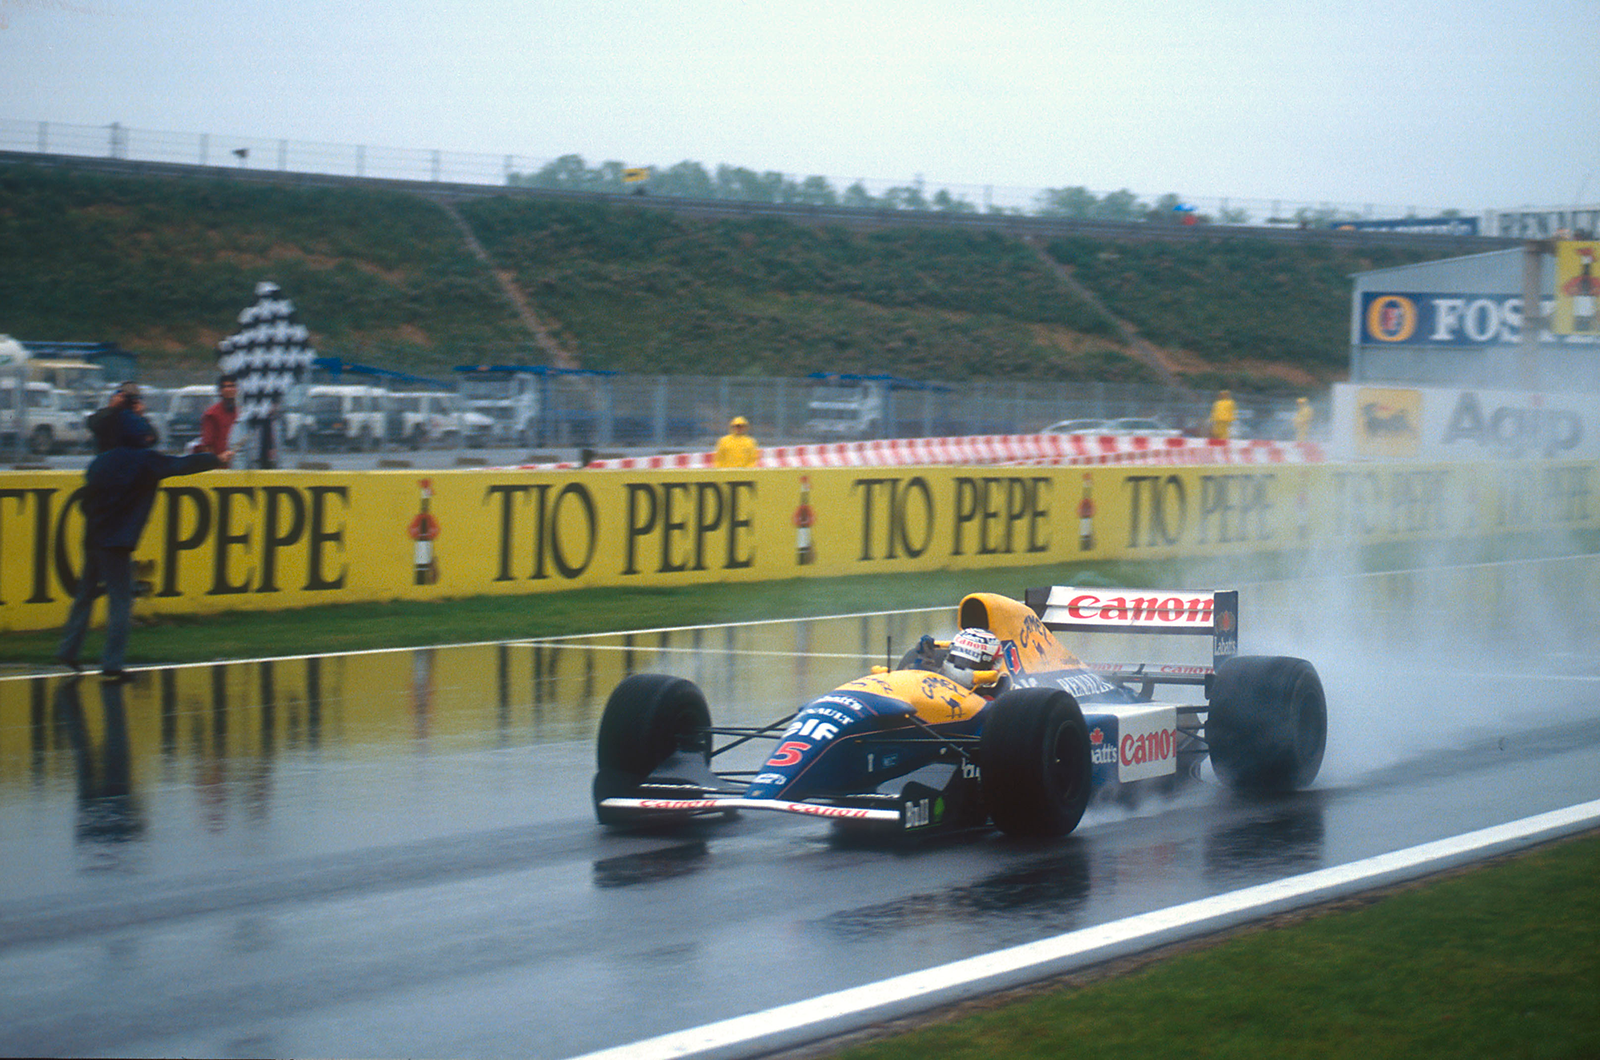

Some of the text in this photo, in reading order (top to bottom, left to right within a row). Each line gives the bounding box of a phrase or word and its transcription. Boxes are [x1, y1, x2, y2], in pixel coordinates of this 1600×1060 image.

[1428, 298, 1600, 343] FOS
[484, 480, 757, 582] TIO PEPE
[854, 476, 1054, 562] TIO PEPE
[1122, 474, 1188, 549] TIO
[156, 486, 351, 599] PEPE
[1068, 594, 1214, 622] Canon
[766, 741, 812, 767] 5
[639, 798, 718, 812] Canon
[788, 802, 870, 818] Canon
